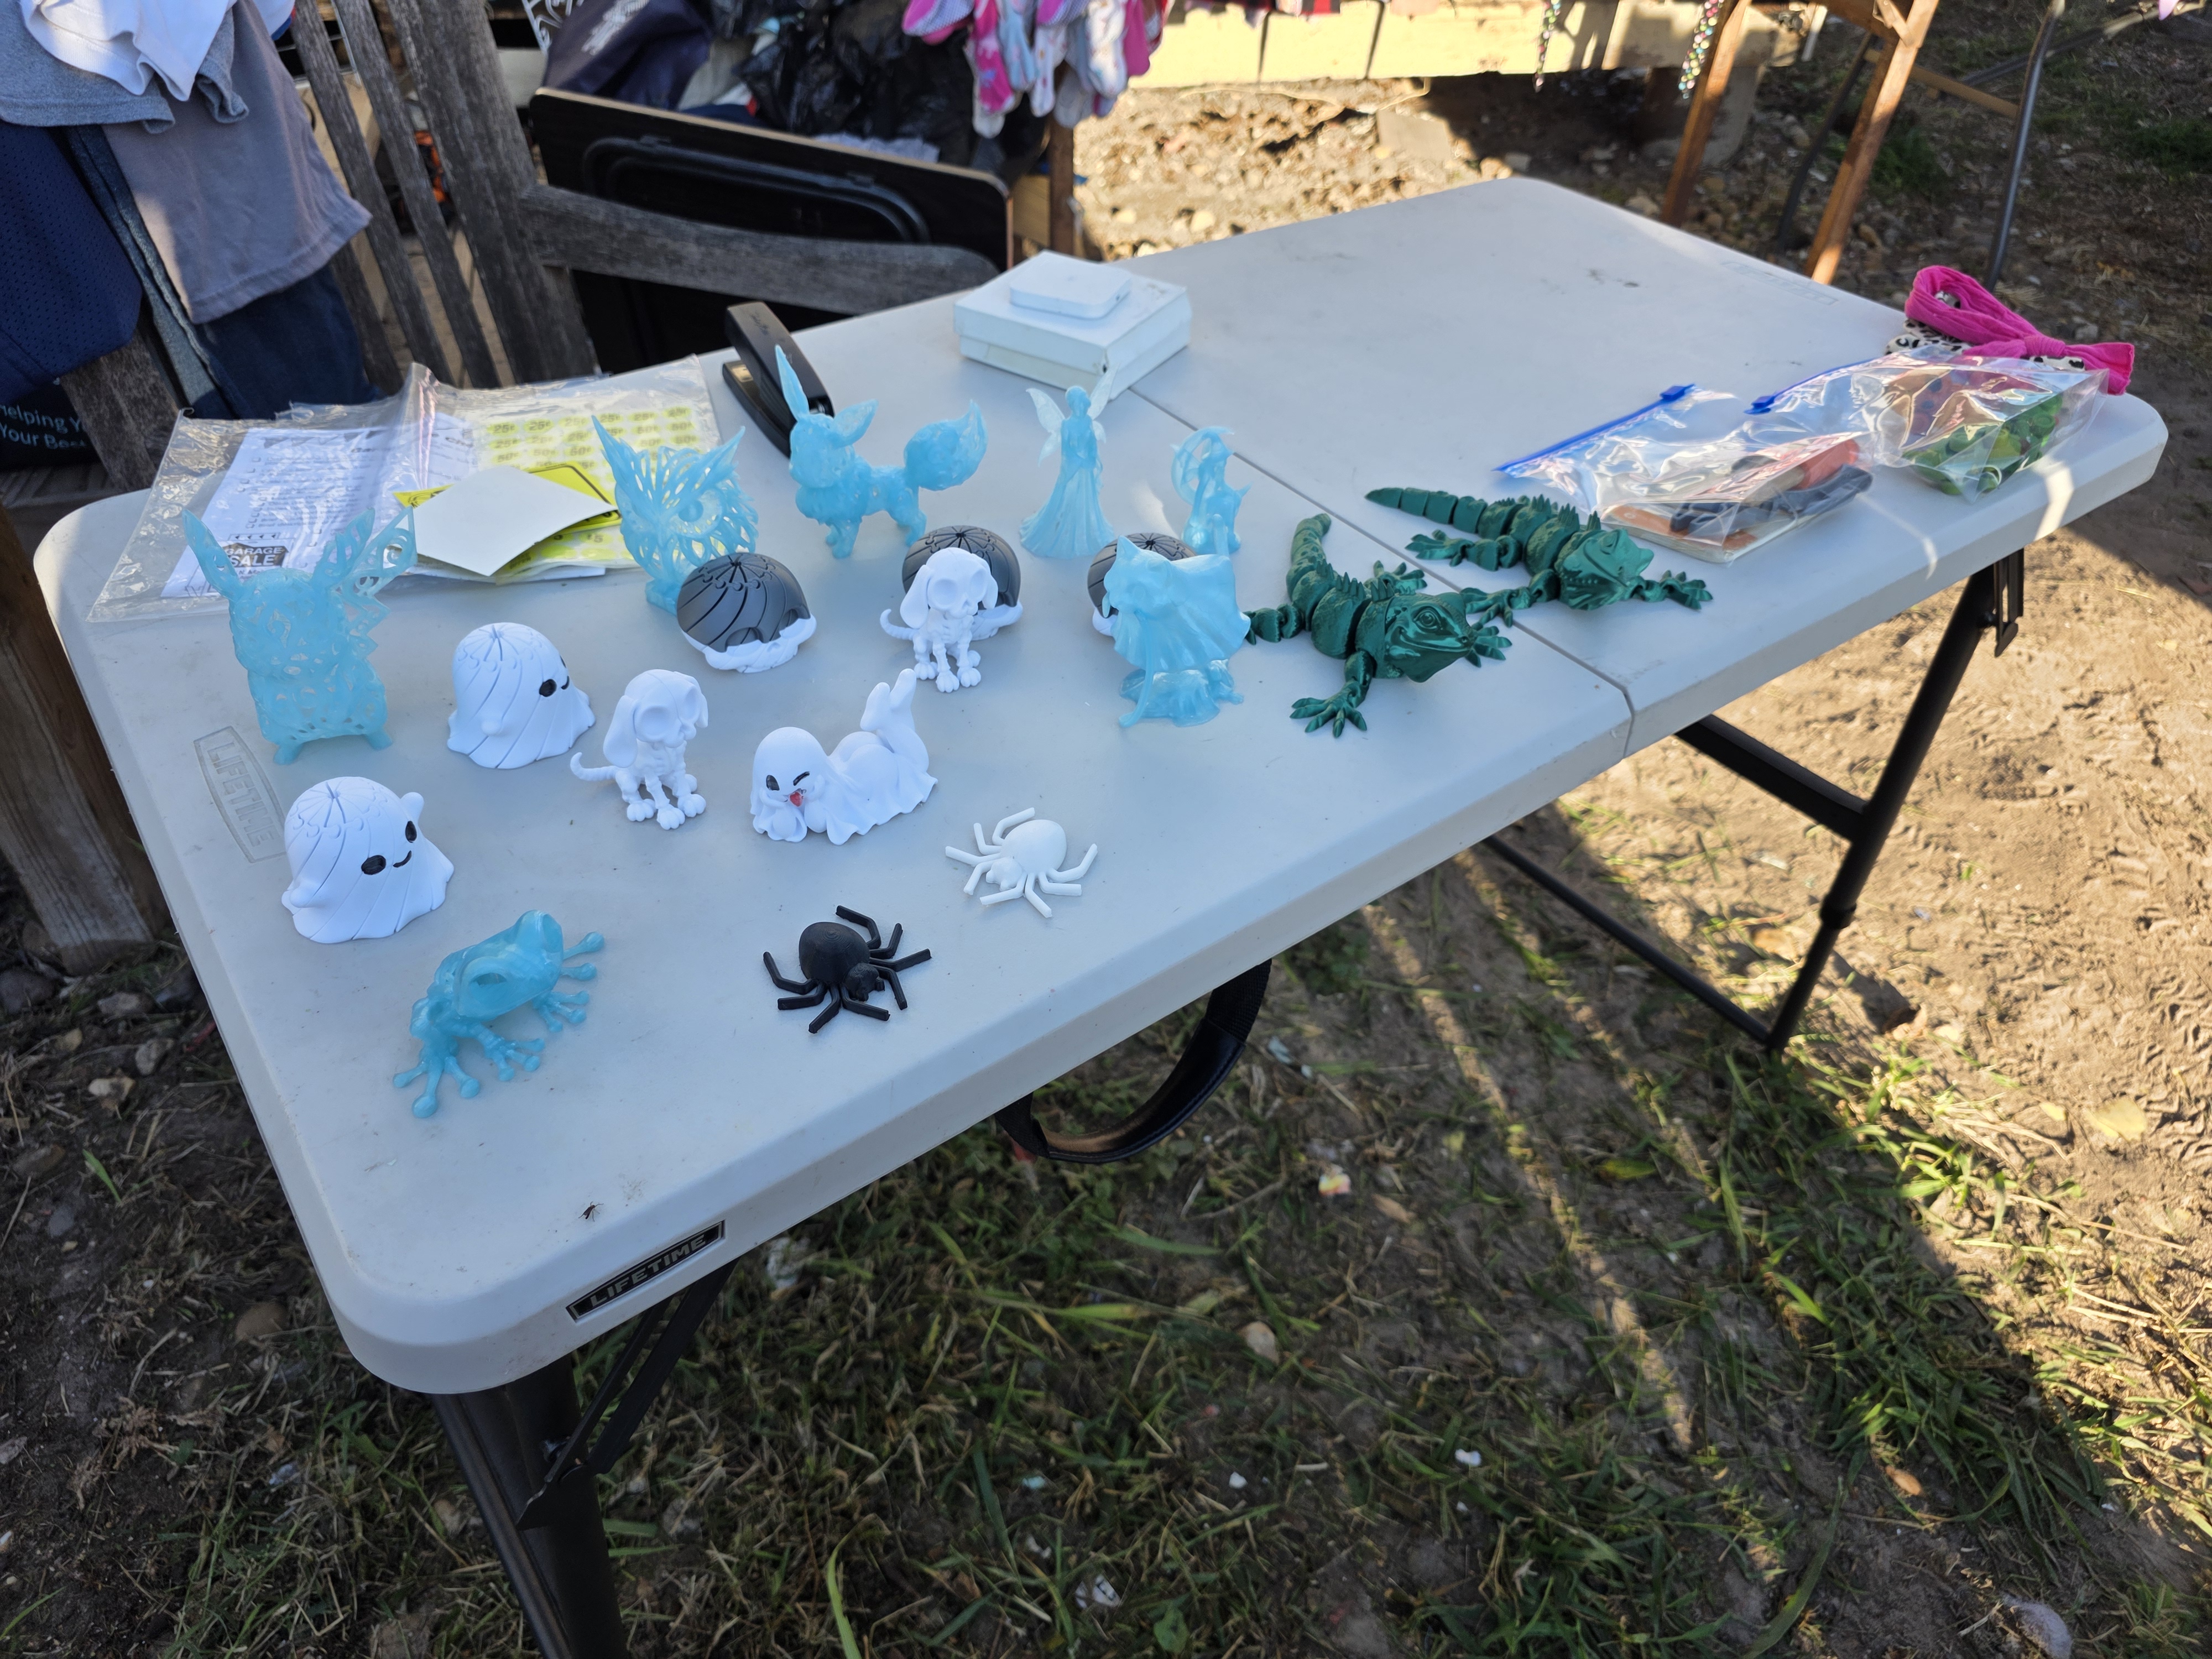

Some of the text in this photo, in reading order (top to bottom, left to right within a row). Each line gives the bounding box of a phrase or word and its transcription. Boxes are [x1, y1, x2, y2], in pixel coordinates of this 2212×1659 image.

[0, 422, 39, 446] Your
[529, 419, 551, 431] 25¢
[225, 547, 283, 555] GARAGE
[229, 555, 275, 566] SALE
[207, 742, 280, 847] LIFETIME
[590, 1234, 706, 1307] LIFETIME
